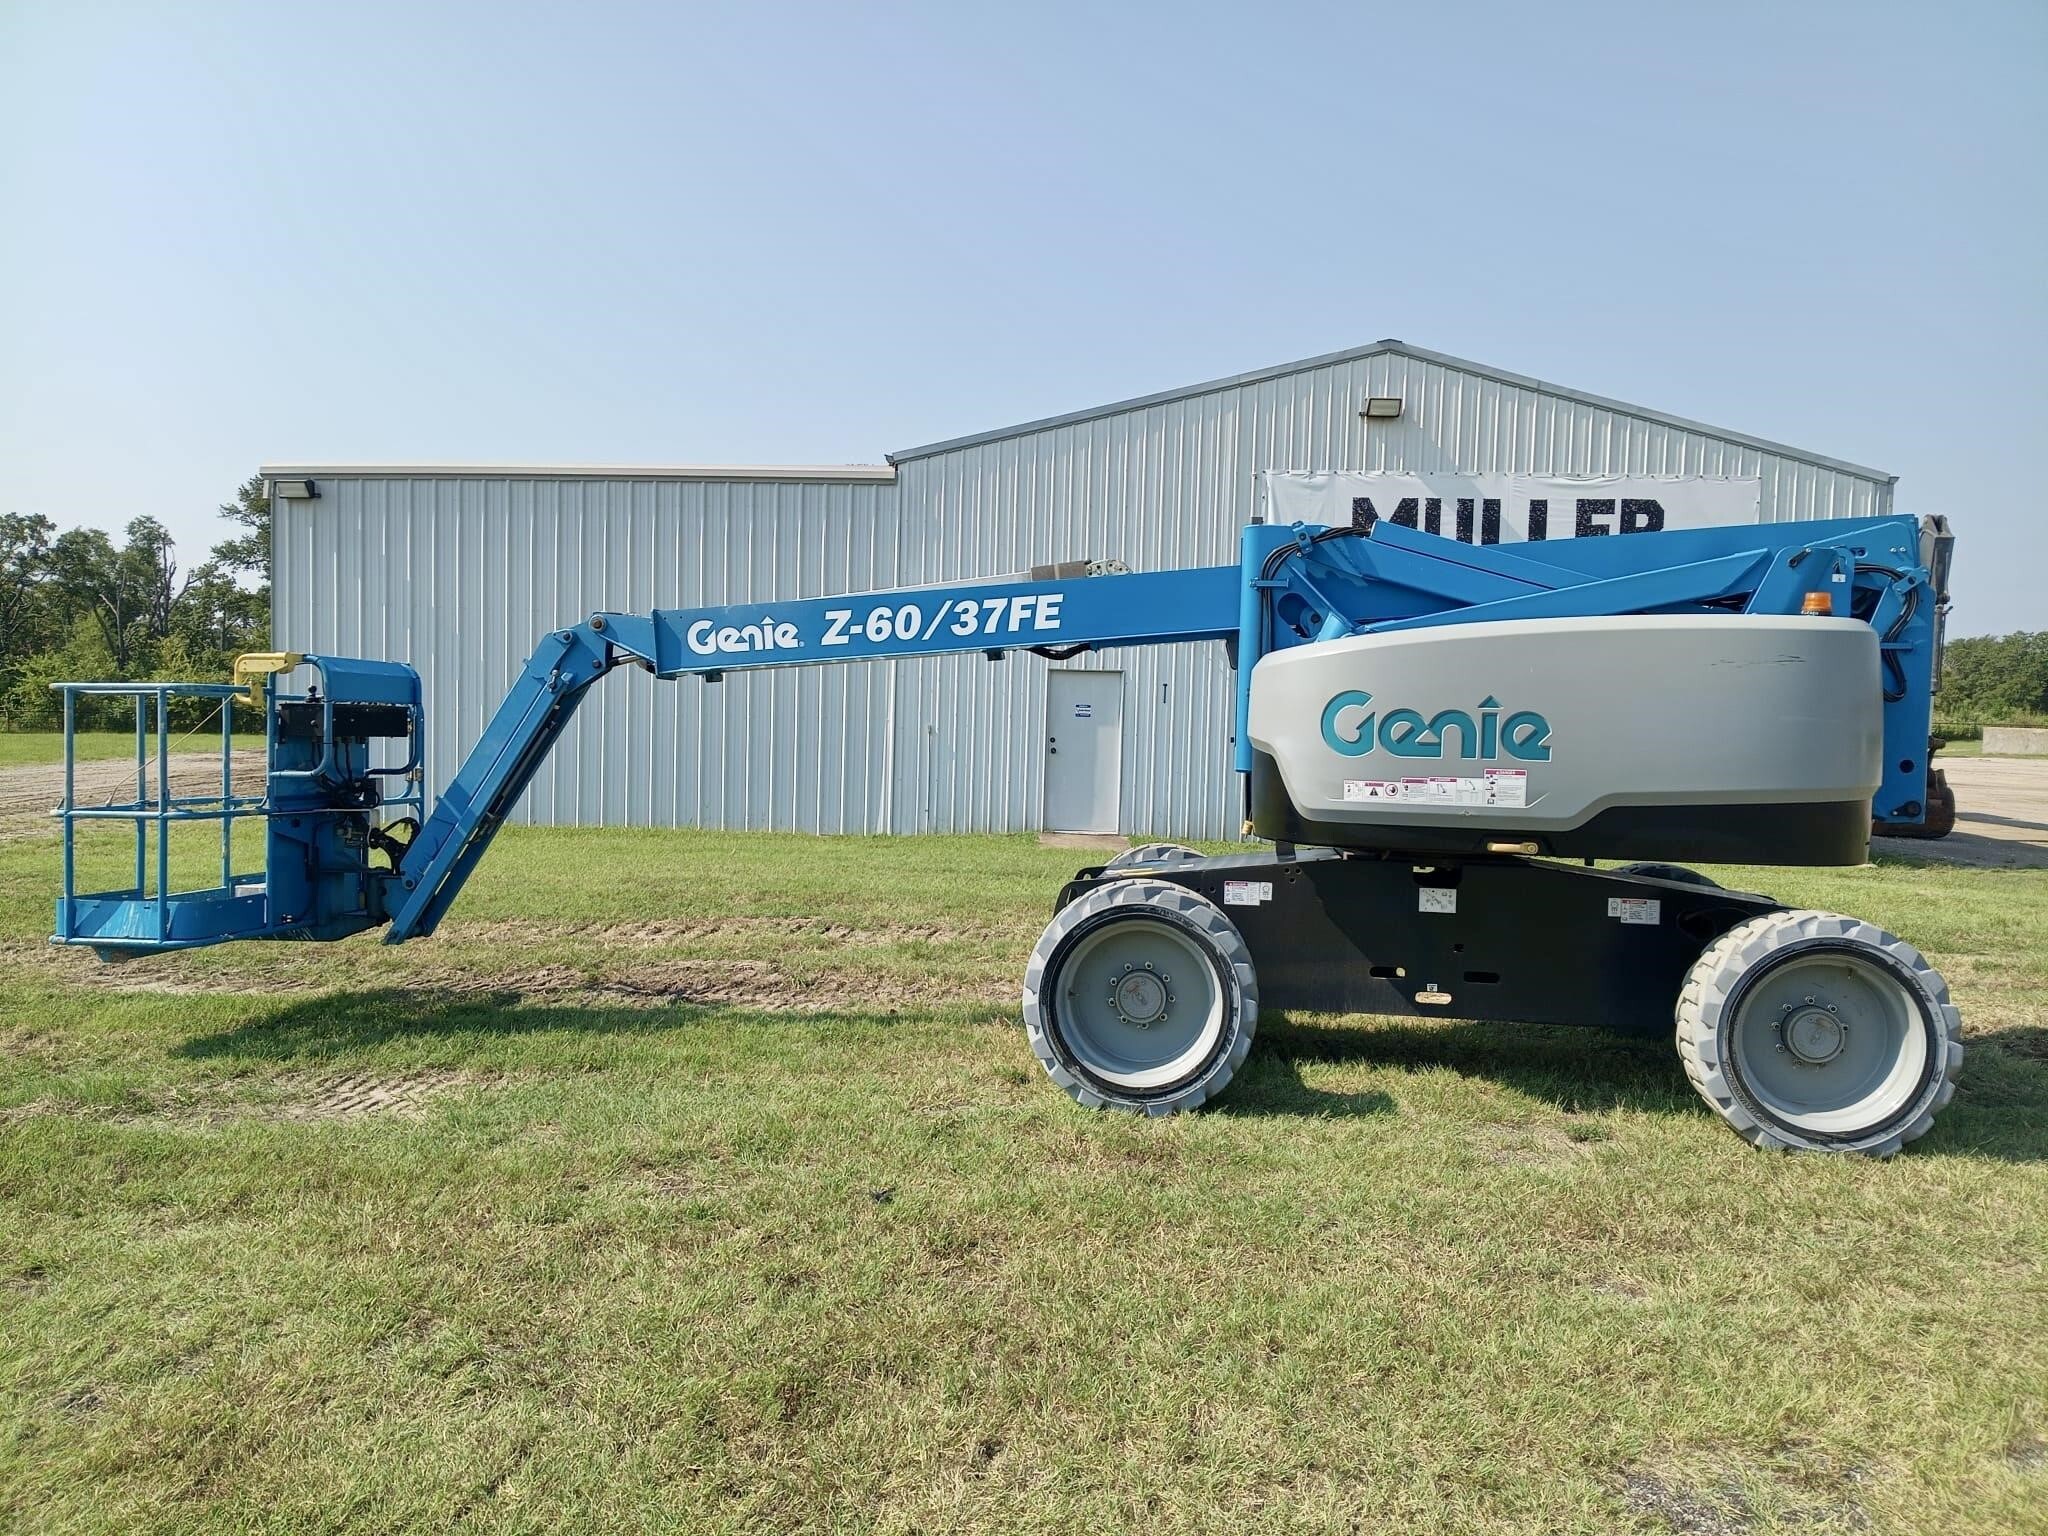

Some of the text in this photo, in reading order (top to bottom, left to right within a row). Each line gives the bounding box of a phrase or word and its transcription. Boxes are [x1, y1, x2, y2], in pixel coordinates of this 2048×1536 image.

[687, 615, 799, 655] Genie
[820, 593, 1064, 646] Z-60/37FE
[1320, 690, 1552, 762] Genie
